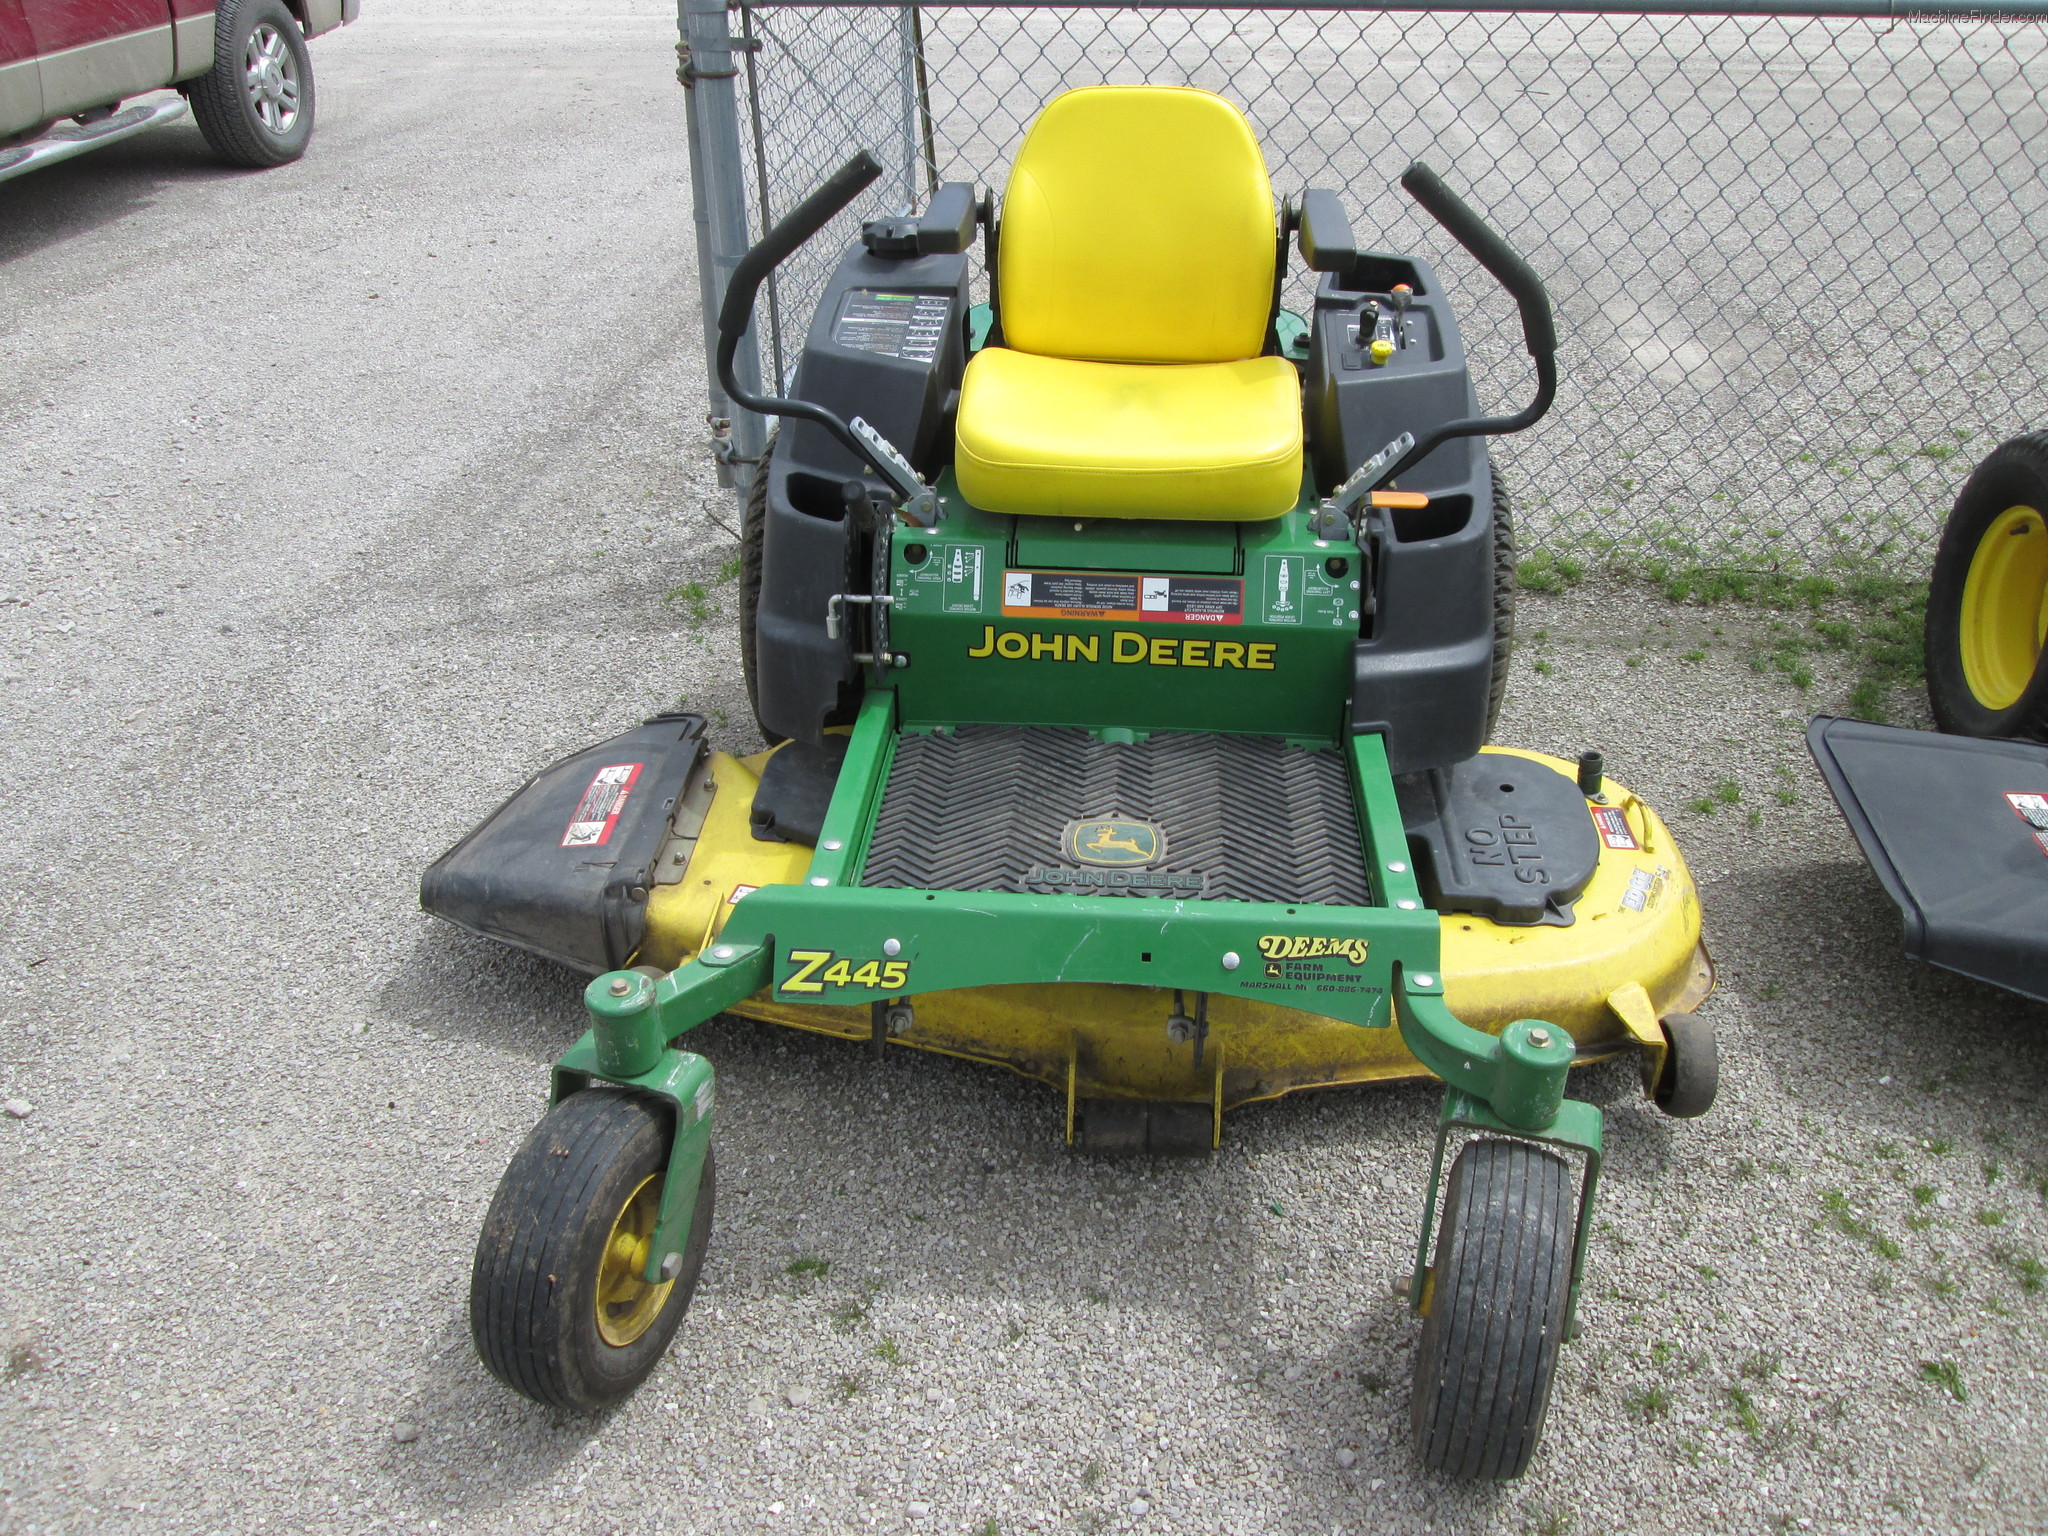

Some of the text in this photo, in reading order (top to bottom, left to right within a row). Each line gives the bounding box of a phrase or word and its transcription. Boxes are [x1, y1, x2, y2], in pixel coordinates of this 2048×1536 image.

[1060, 609, 1098, 617] WARNING
[1185, 614, 1216, 622] DANGER
[967, 624, 1278, 671] JOHN DEERE
[1464, 827, 1505, 866] NO
[1498, 814, 1551, 885] STEP
[1026, 869, 1204, 889] JOHN DEERE
[1621, 867, 1655, 913] EDGE
[1257, 935, 1370, 967] DEEMS
[777, 948, 912, 995] Z445
[1285, 962, 1324, 972] FARM
[1285, 972, 1362, 983] EQUIPMENT
[1240, 981, 1292, 991] MARSHALL
